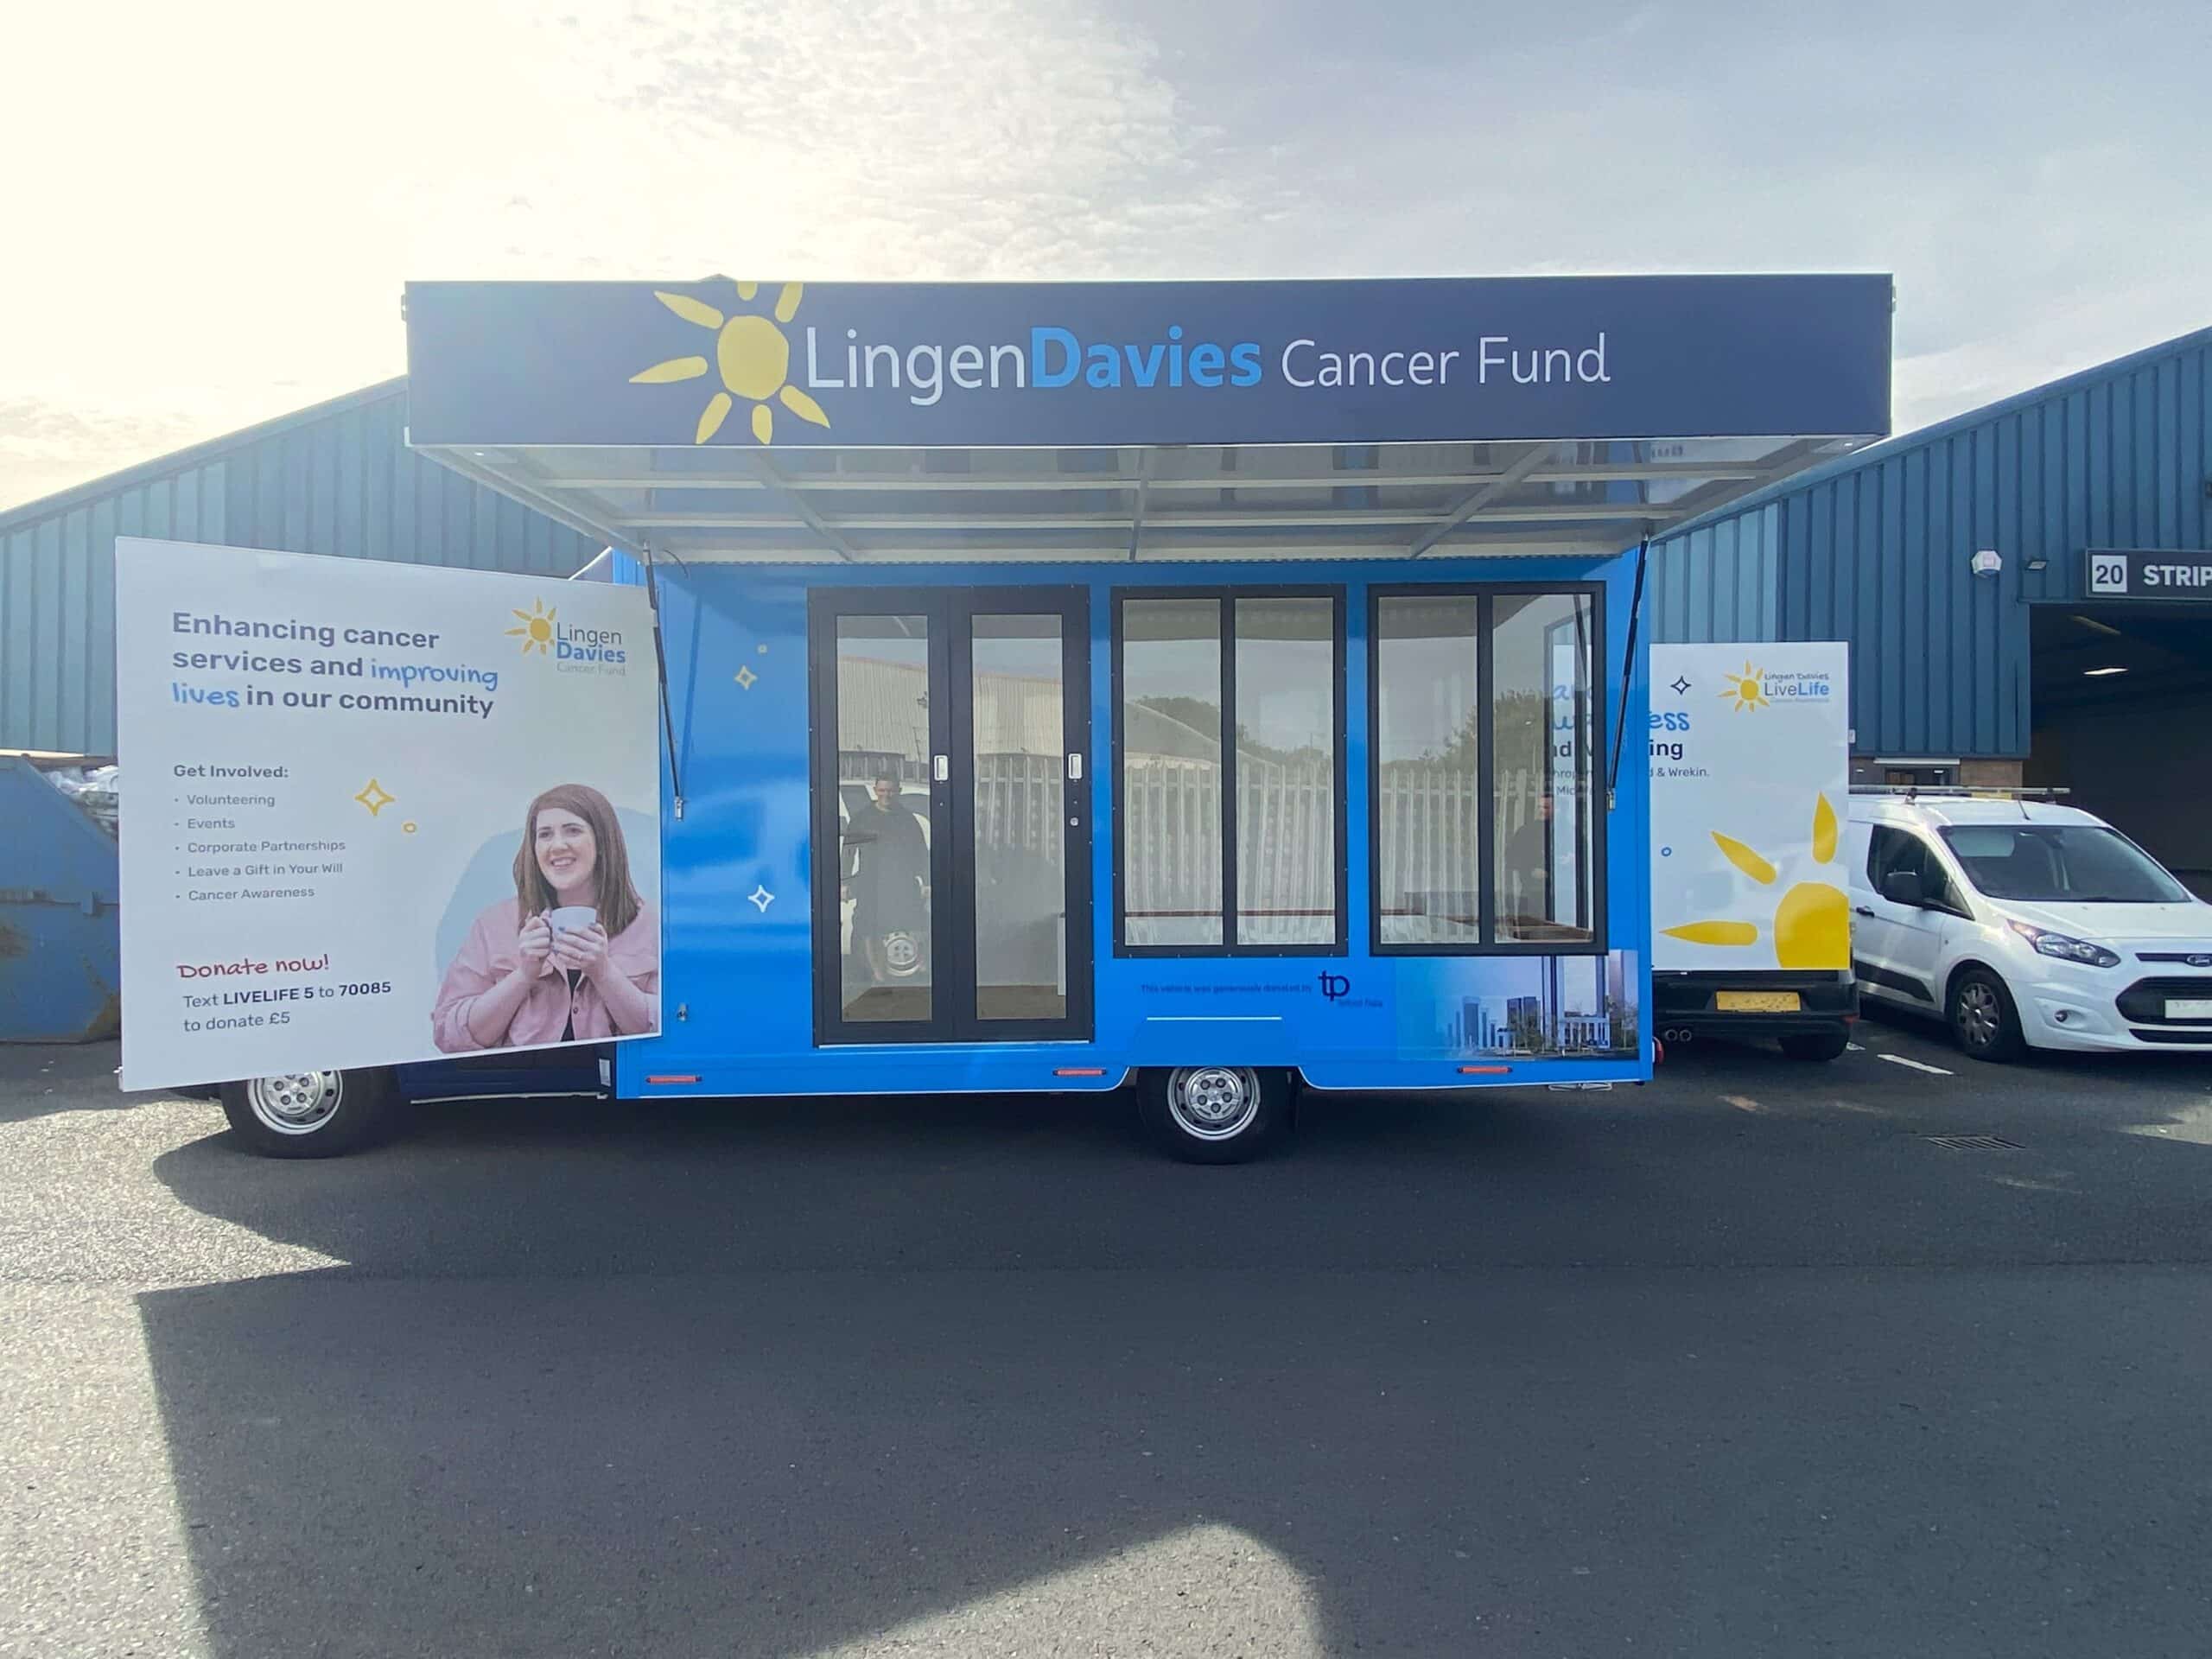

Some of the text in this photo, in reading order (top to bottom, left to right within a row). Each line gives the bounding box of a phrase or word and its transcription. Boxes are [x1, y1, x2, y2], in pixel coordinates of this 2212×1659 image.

[1281, 338, 1460, 387] Cancer
[1478, 332, 1611, 385] Fund
[2095, 564, 2123, 584] 20
[173, 612, 440, 648] Enhancing cancer
[556, 621, 622, 647] Lingen
[556, 641, 626, 664] Davies
[173, 651, 499, 691] services and improving
[1764, 682, 1829, 696] LiveLife
[172, 682, 494, 719] lives in our community
[174, 765, 289, 779] Get Involved:
[1657, 766, 1666, 778] &
[187, 794, 276, 808] Volunteering
[187, 817, 236, 830] Events
[187, 840, 346, 855] Corporate Partnerships
[188, 862, 343, 877] Leave a Gift in Your Will
[188, 887, 315, 901] Cancer Awareness
[176, 954, 329, 978] Donate now!
[182, 982, 391, 1008] Text LIVELIFE 5 to 70085
[184, 1011, 291, 1032] to donate £5
